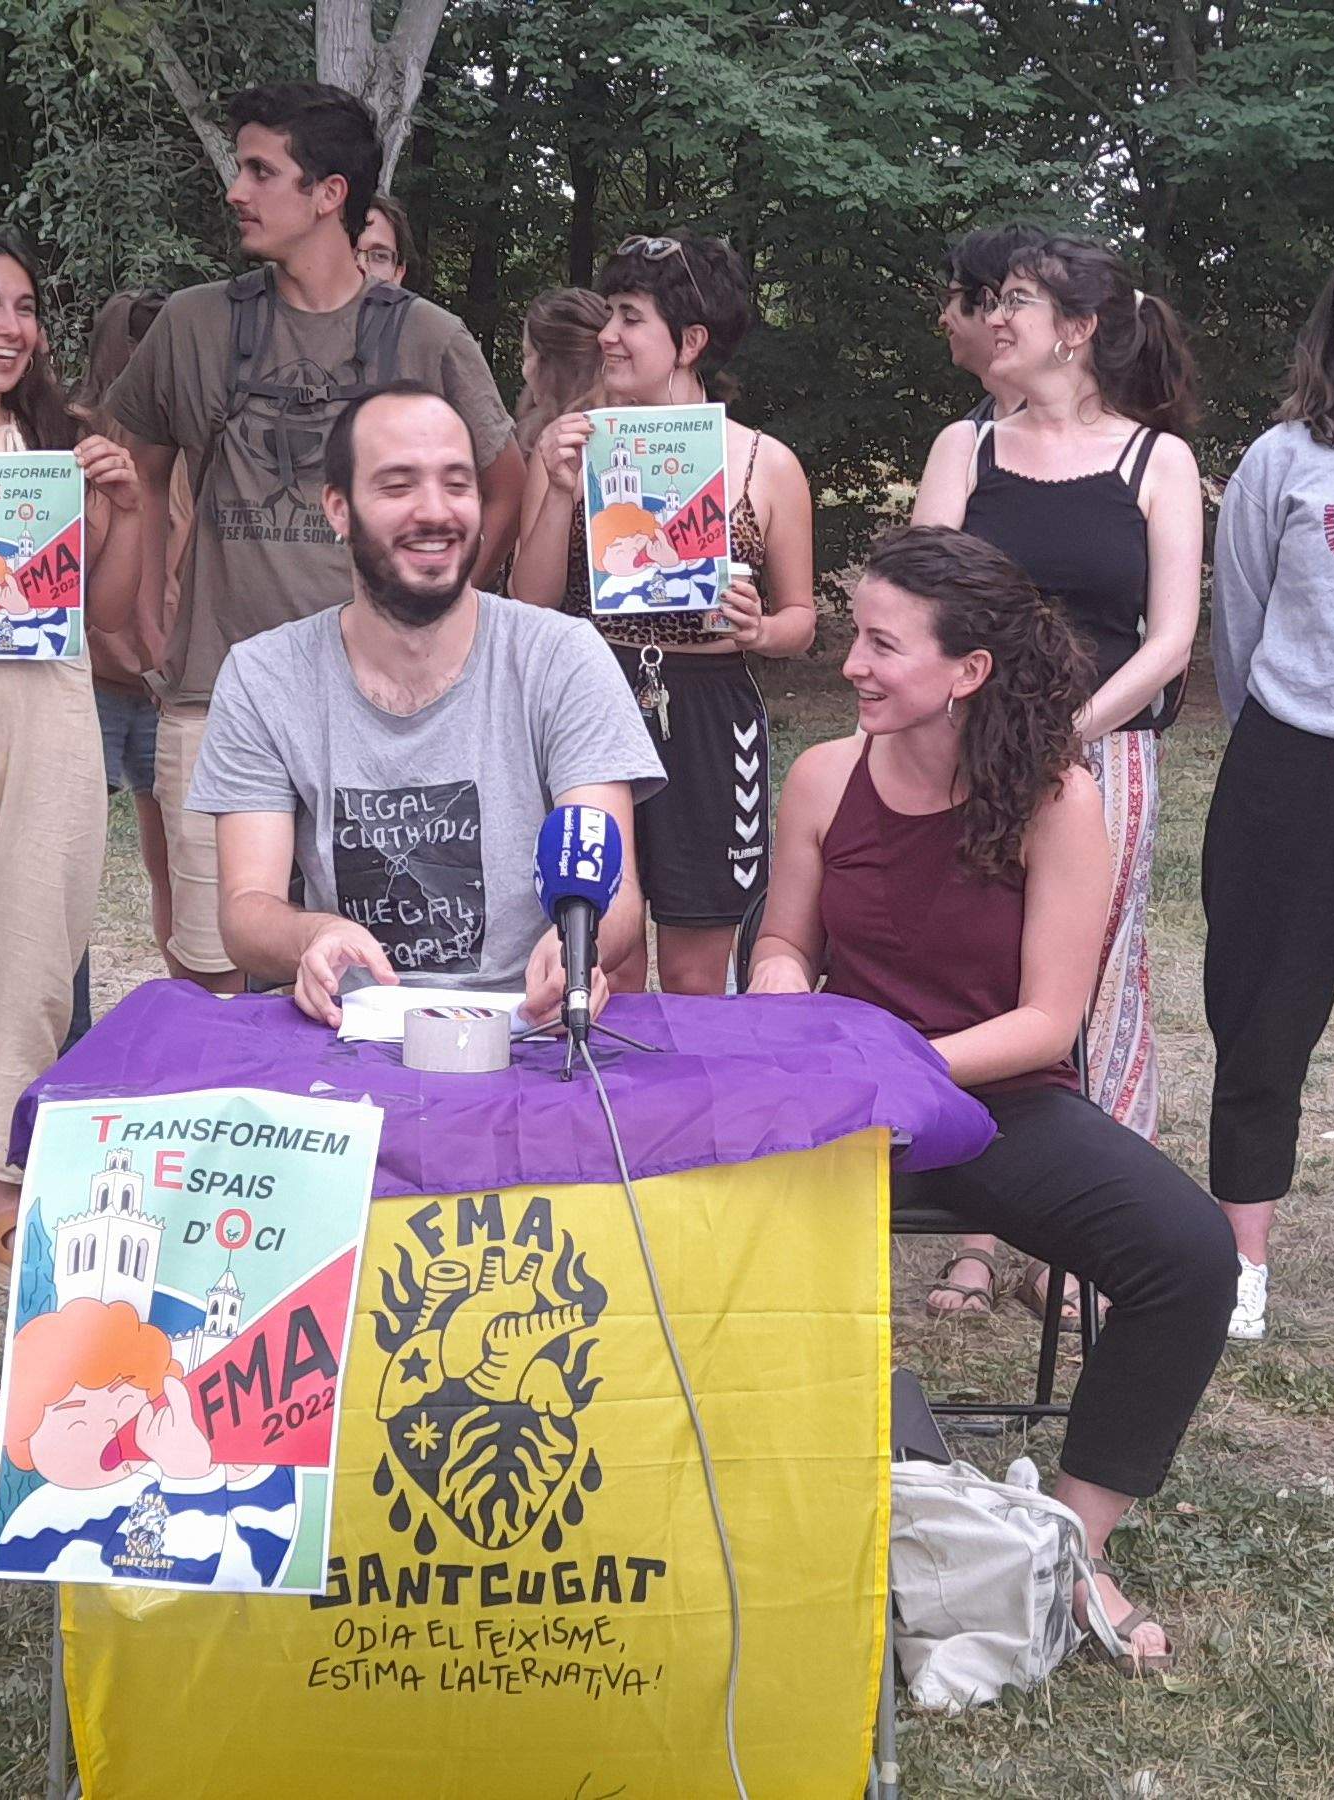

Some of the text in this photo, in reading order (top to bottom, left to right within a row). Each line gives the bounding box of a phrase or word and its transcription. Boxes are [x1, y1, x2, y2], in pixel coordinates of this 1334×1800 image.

[605, 417, 713, 435] TRANSFORMEM
[634, 438, 687, 456] ESPAIS
[668, 493, 726, 552] FMA
[18, 542, 81, 600] FMA
[344, 792, 435, 821] LEGAL
[91, 1114, 350, 1156] TRANSFORMEM
[153, 1150, 276, 1199] ESPAIS
[182, 1208, 286, 1252] D'OCI
[406, 1193, 554, 1259] FMA
[198, 1305, 339, 1441] FMA
[262, 1386, 335, 1447] 2022
[334, 1615, 416, 1654] ODIA
[427, 1619, 464, 1650] EL
[308, 1657, 425, 1692] ESTIMA
